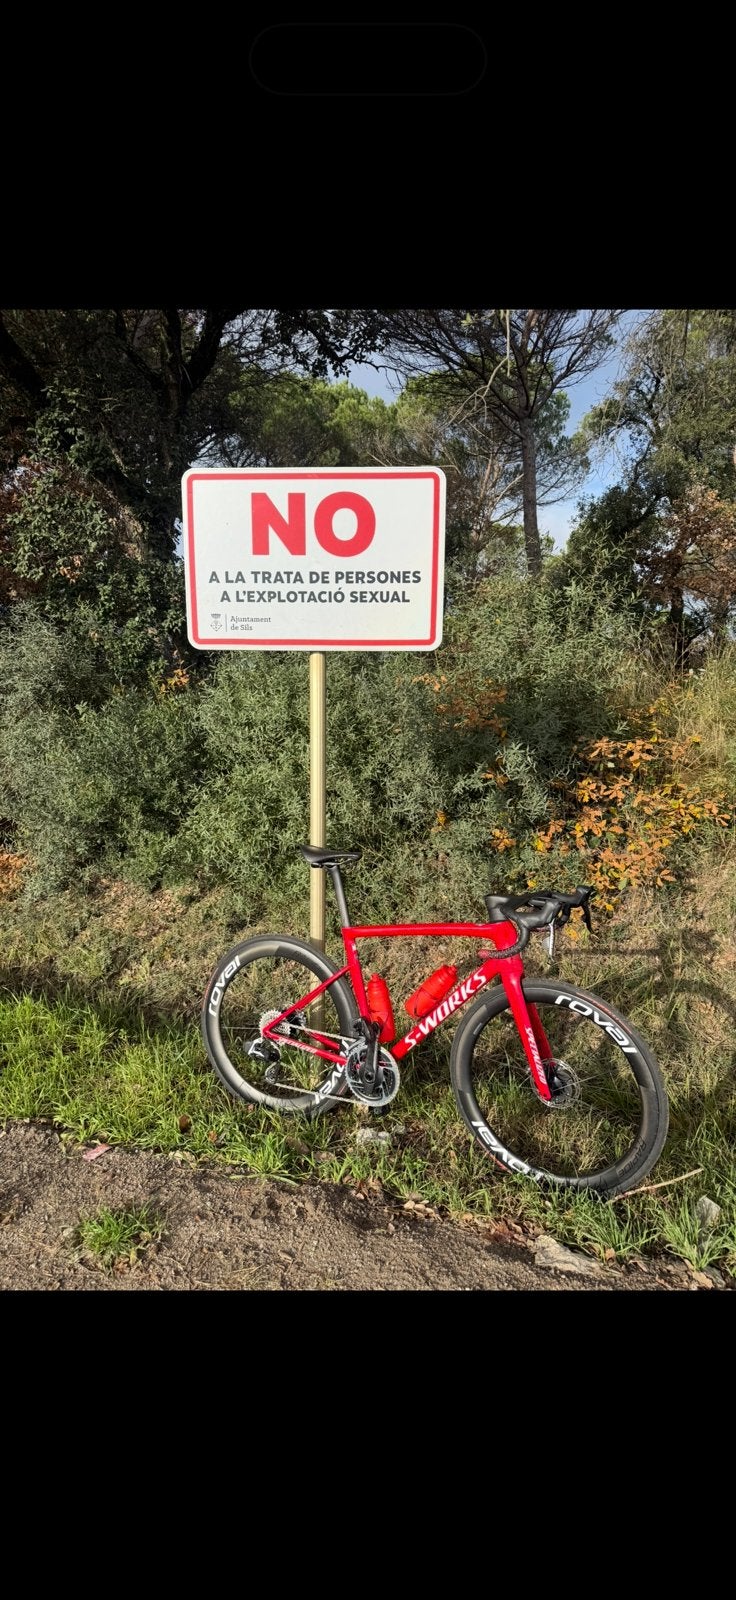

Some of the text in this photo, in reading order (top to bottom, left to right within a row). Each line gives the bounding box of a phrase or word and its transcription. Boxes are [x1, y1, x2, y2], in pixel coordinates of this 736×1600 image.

[251, 491, 376, 557] NO
[209, 570, 421, 584] A LA TRATA DE PERSONES
[220, 590, 231, 603] A
[350, 590, 410, 603] SEXUAL
[230, 615, 271, 623] Ajuntament
[404, 967, 487, 1051] S-WORKS
